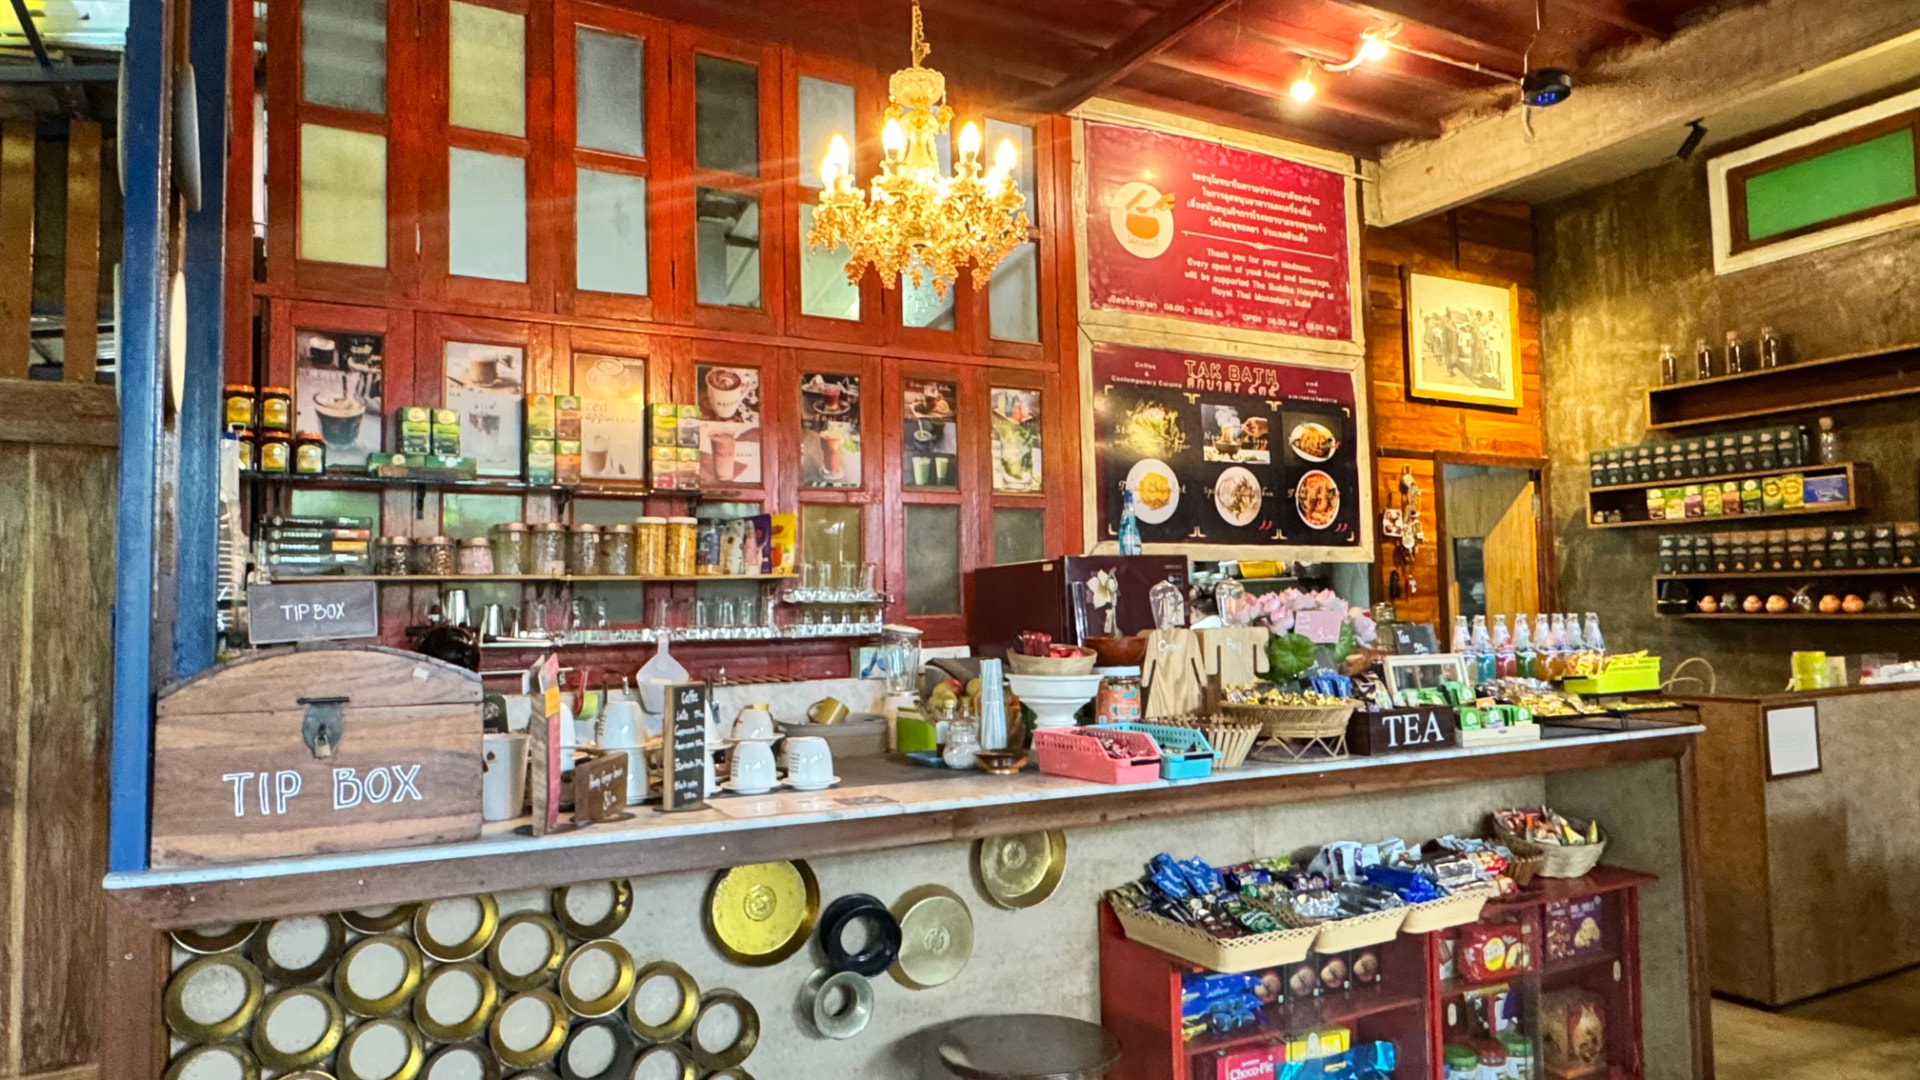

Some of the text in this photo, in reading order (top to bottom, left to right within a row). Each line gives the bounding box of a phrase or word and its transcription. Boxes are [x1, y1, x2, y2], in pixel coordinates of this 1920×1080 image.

[1187, 257, 1209, 270] Every
[1211, 262, 1232, 273] spent
[1234, 265, 1243, 274] of
[1264, 270, 1281, 280] food
[1283, 274, 1296, 283] and
[1207, 248, 1229, 259] Thank
[1232, 254, 1246, 262] you
[1249, 256, 1260, 264] for
[1262, 259, 1278, 268] your
[1184, 271, 1197, 280] will
[1200, 272, 1210, 281] be
[1213, 275, 1249, 288] supported
[1252, 280, 1266, 290] The
[1268, 282, 1294, 295] Buddha
[1297, 287, 1325, 299] Hospital
[1211, 287, 1233, 298] Royal
[1236, 290, 1251, 300] Thai
[1295, 299, 1312, 309] India
[1242, 313, 1262, 323] OPEN
[1111, 375, 1183, 389] Contemporary Cuisine
[1184, 359, 1277, 386] TAK BATH
[280, 602, 346, 622] TIP BOX
[1382, 710, 1445, 747] TEA
[222, 764, 423, 817] TIP BOX
